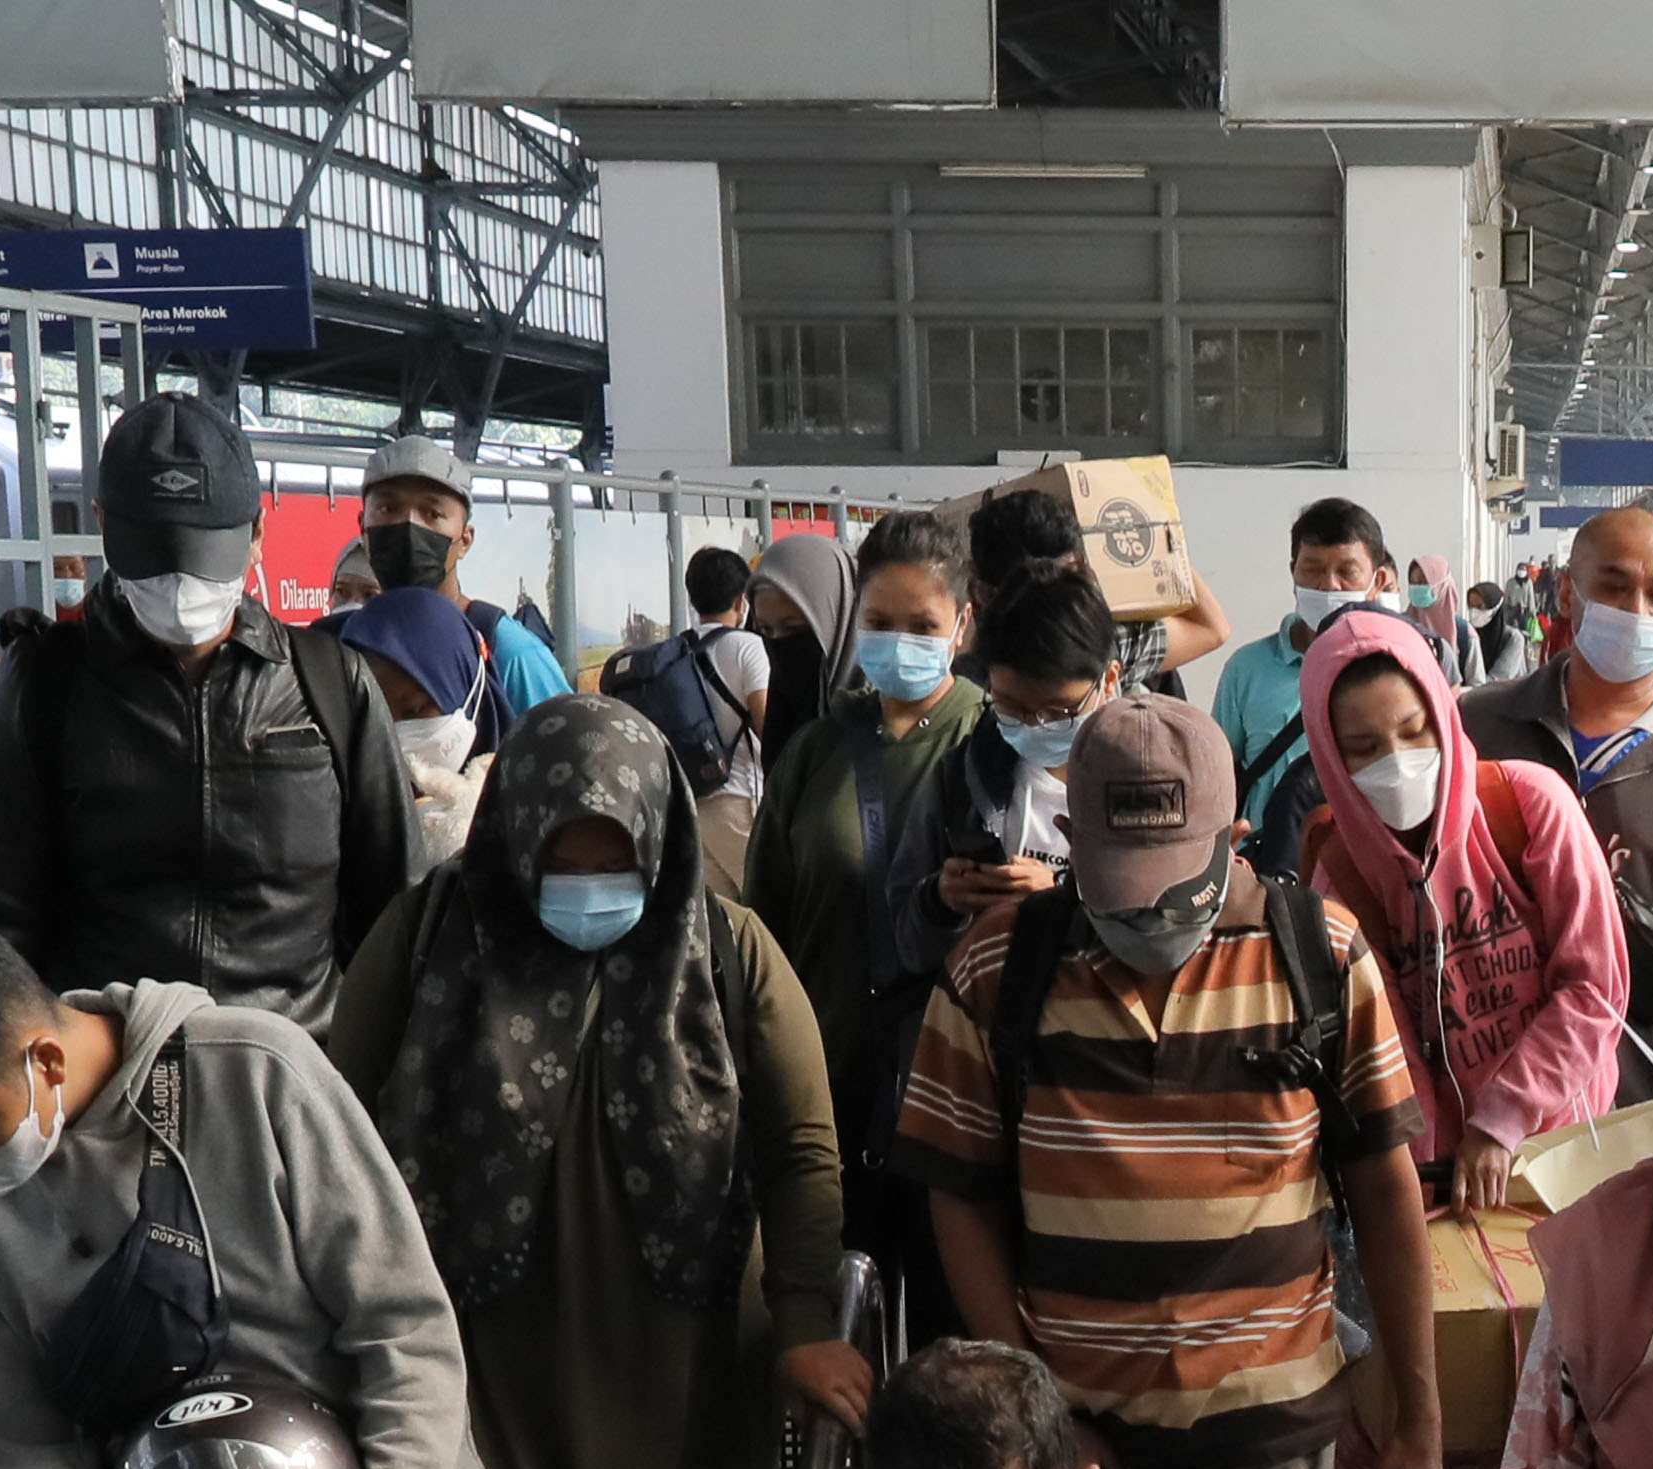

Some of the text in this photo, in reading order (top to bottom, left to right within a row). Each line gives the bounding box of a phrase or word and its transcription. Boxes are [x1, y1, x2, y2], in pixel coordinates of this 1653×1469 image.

[134, 246, 179, 259] Musala
[136, 264, 185, 274] Prayer Room
[142, 305, 227, 319] Area Merokok
[143, 324, 195, 334] Smoking Area
[279, 579, 330, 617] Dilarang
[1457, 1017, 1514, 1070] LIVE
